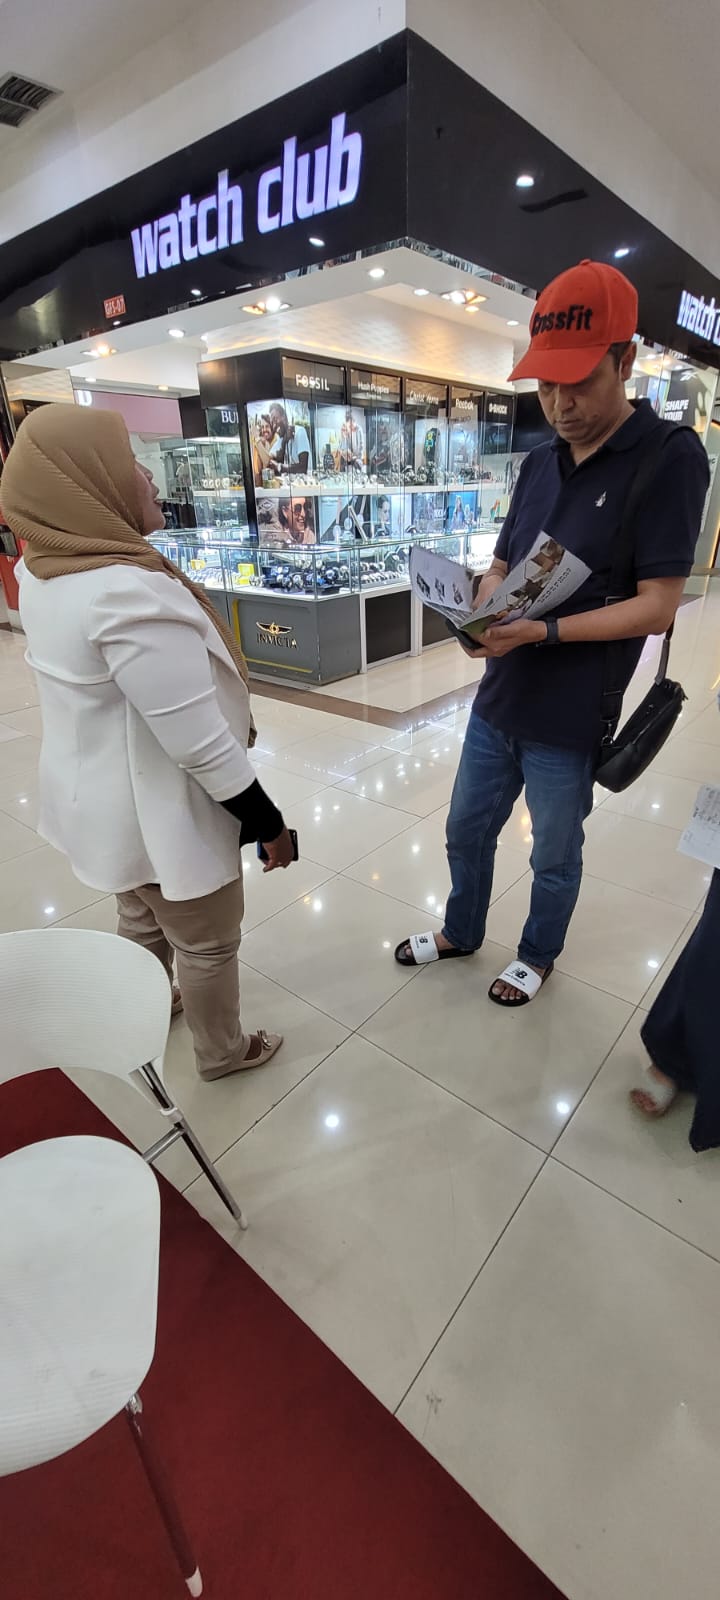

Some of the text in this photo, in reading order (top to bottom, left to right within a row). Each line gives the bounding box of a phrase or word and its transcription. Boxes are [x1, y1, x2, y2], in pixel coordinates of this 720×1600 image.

[130, 111, 363, 279] watch club
[676, 290, 716, 341] watch
[295, 373, 330, 392] FOSSIL
[665, 399, 689, 411] SHAPE
[256, 632, 297, 649] INVICTA
